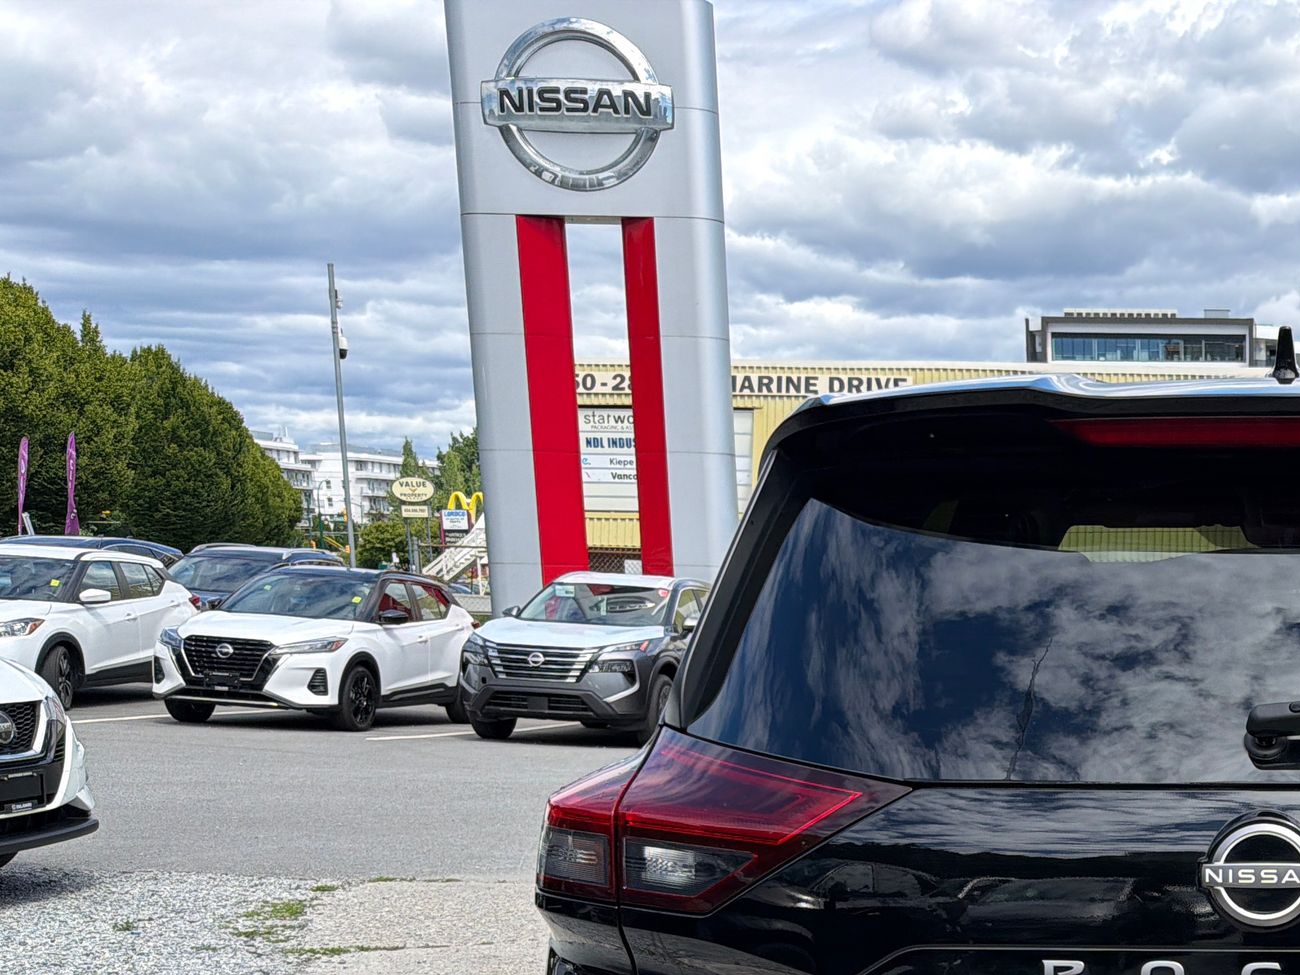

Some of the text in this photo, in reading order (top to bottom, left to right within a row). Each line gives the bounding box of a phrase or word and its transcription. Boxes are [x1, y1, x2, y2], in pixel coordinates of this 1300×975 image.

[498, 86, 652, 118] NISSAN
[575, 373, 631, 392] 0-2
[732, 375, 819, 394] ARINE
[585, 437, 605, 448] NDL
[609, 457, 634, 467] Kiepe
